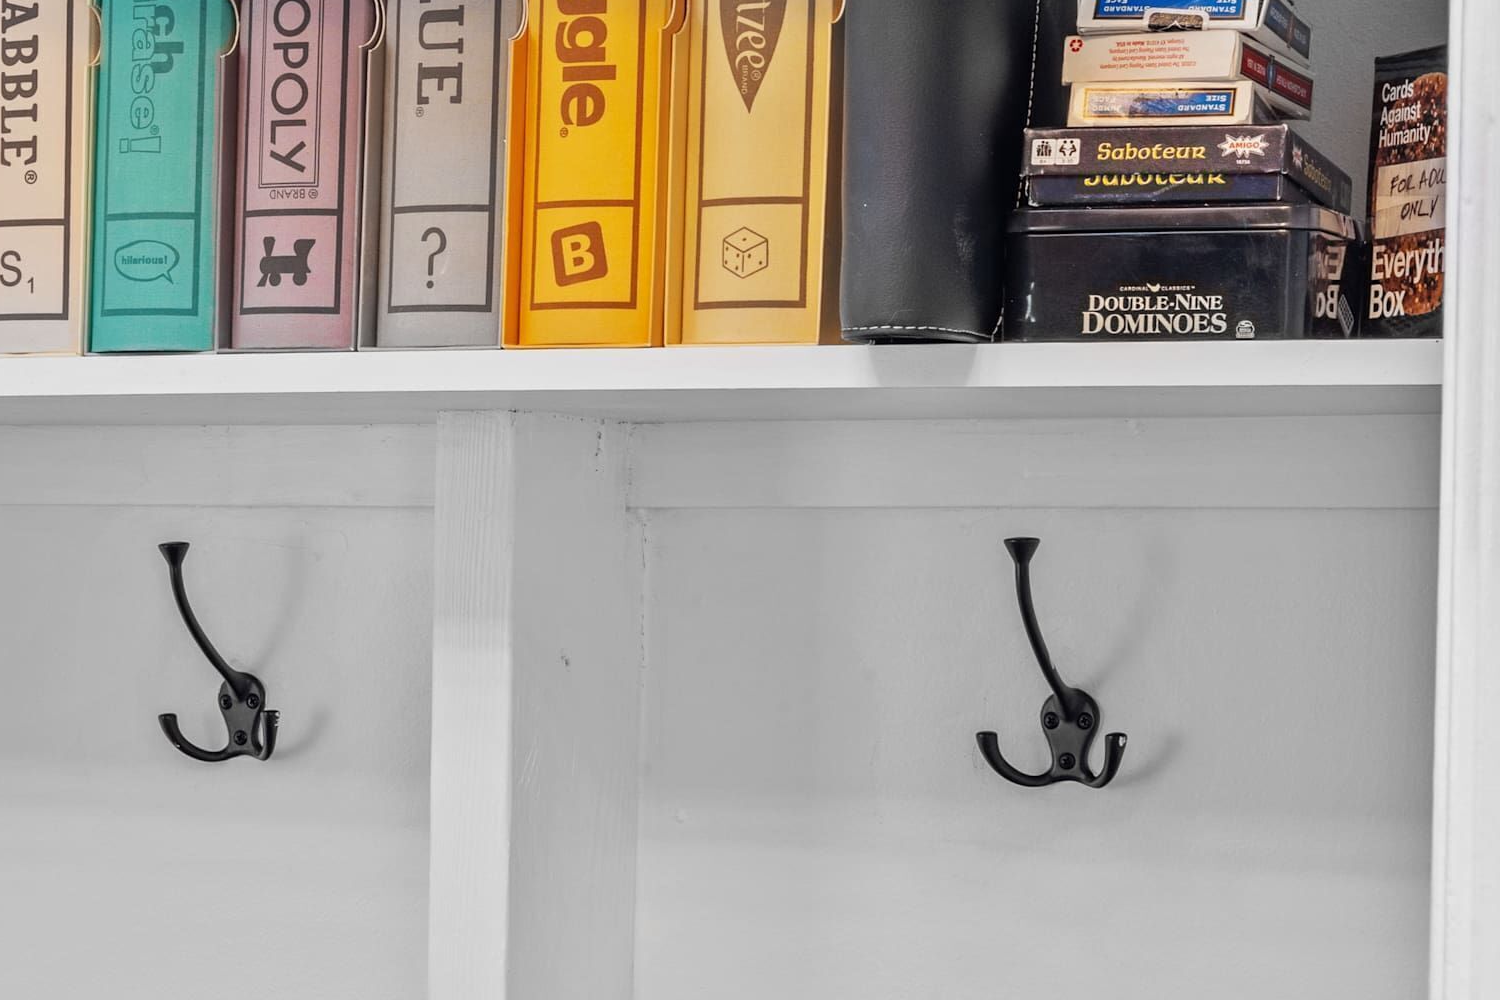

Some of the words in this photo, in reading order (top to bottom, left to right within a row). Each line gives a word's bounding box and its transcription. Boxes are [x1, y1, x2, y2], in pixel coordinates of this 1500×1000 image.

[1206, 94, 1228, 102] SIZE
[1381, 80, 1415, 102] Cards
[1178, 103, 1227, 112] STANDARD
[1380, 101, 1421, 128] Against
[1228, 139, 1260, 150] AMIGO
[1378, 123, 1432, 149] Humanity
[1097, 141, 1207, 161] Saboteur
[1389, 174, 1415, 197] FOR
[1400, 195, 1439, 220] ONLY
[121, 254, 168, 266] hilarious!
[1088, 293, 1223, 311] DOUBLE-NINE
[1369, 284, 1405, 320] Box
[1081, 312, 1228, 335] DOMINOES
